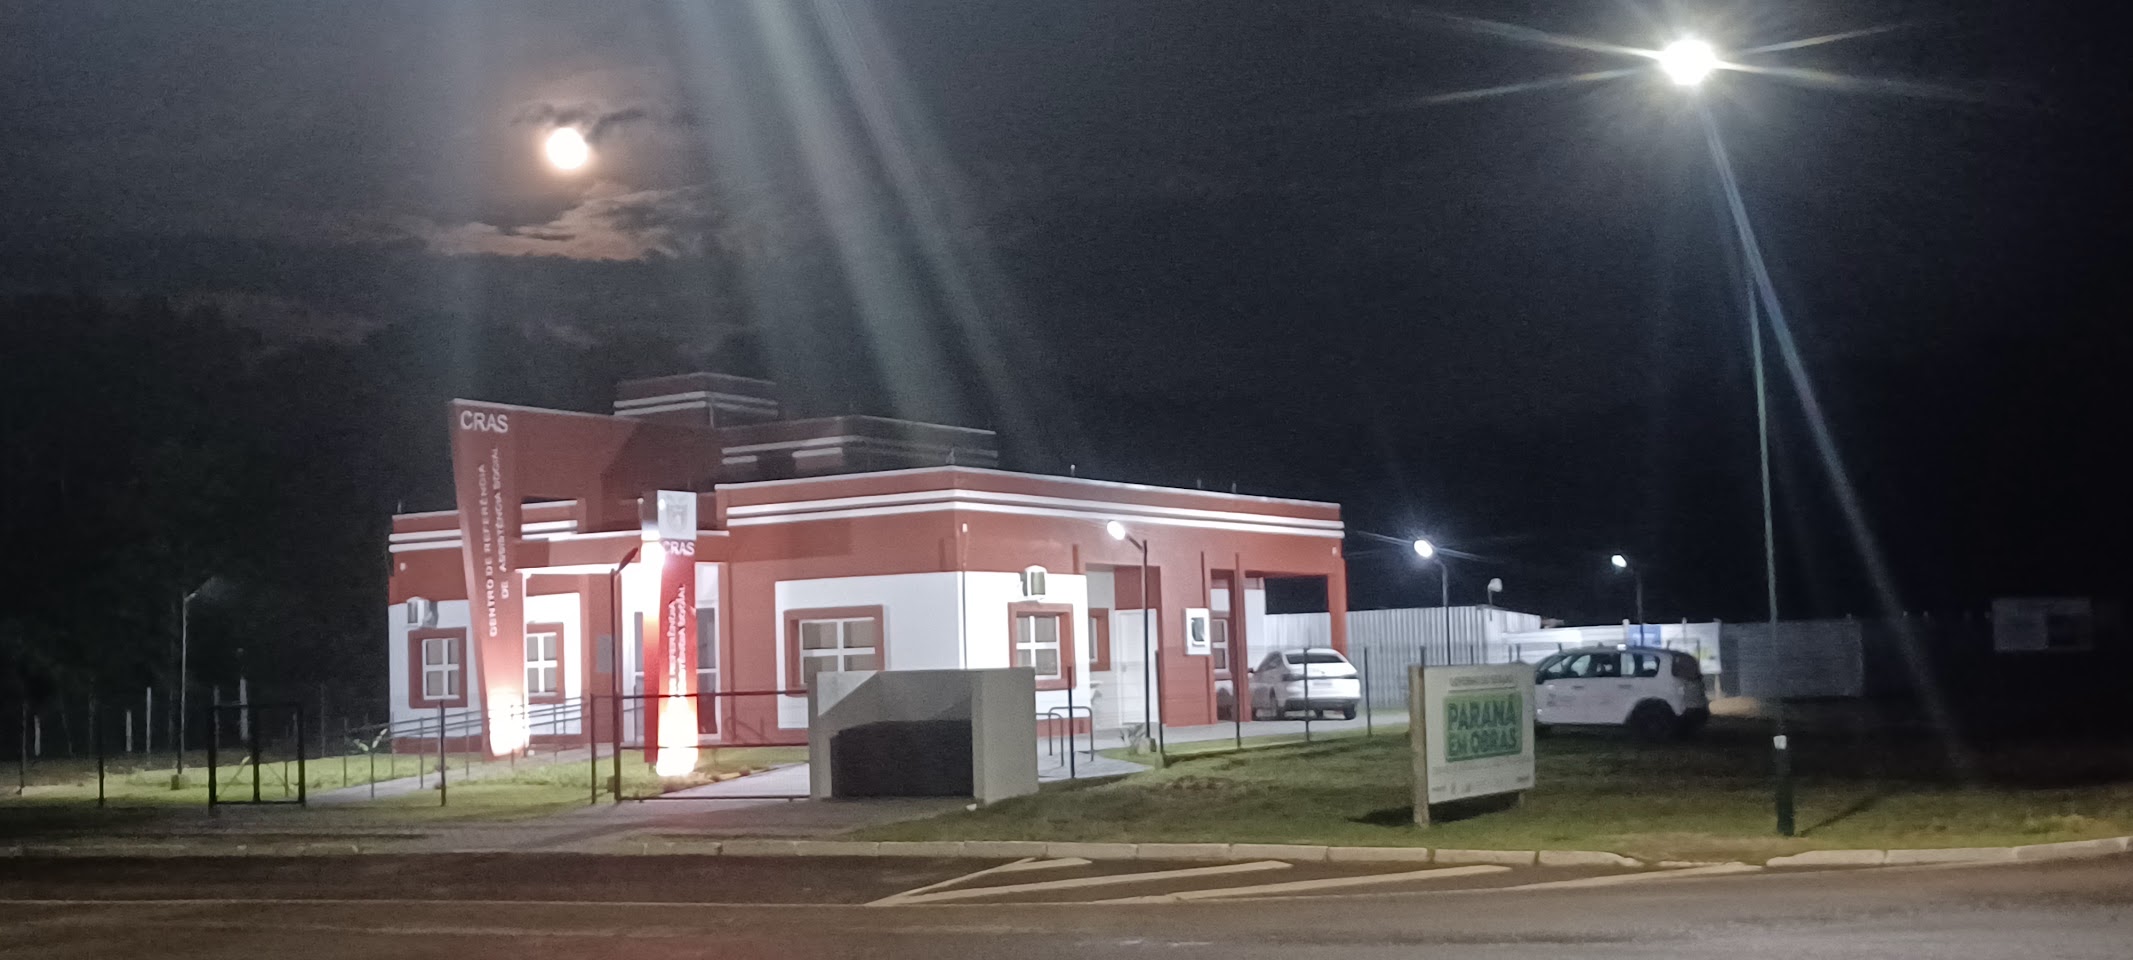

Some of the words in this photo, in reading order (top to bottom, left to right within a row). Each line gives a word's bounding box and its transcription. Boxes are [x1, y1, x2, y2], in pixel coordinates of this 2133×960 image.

[460, 410, 508, 433] CRAS
[491, 448, 501, 490] SOCIAL
[478, 464, 491, 553] REFERÊNCIA
[495, 492, 507, 573] ASSISTÊNCIA
[662, 540, 696, 556] CRAS
[484, 557, 493, 577] DE
[501, 581, 509, 599] DE
[486, 579, 497, 637] CENTRO
[1447, 693, 1517, 731] PARANÁ
[1447, 732, 1468, 757] EM
[1471, 727, 1518, 753] OBRAS
